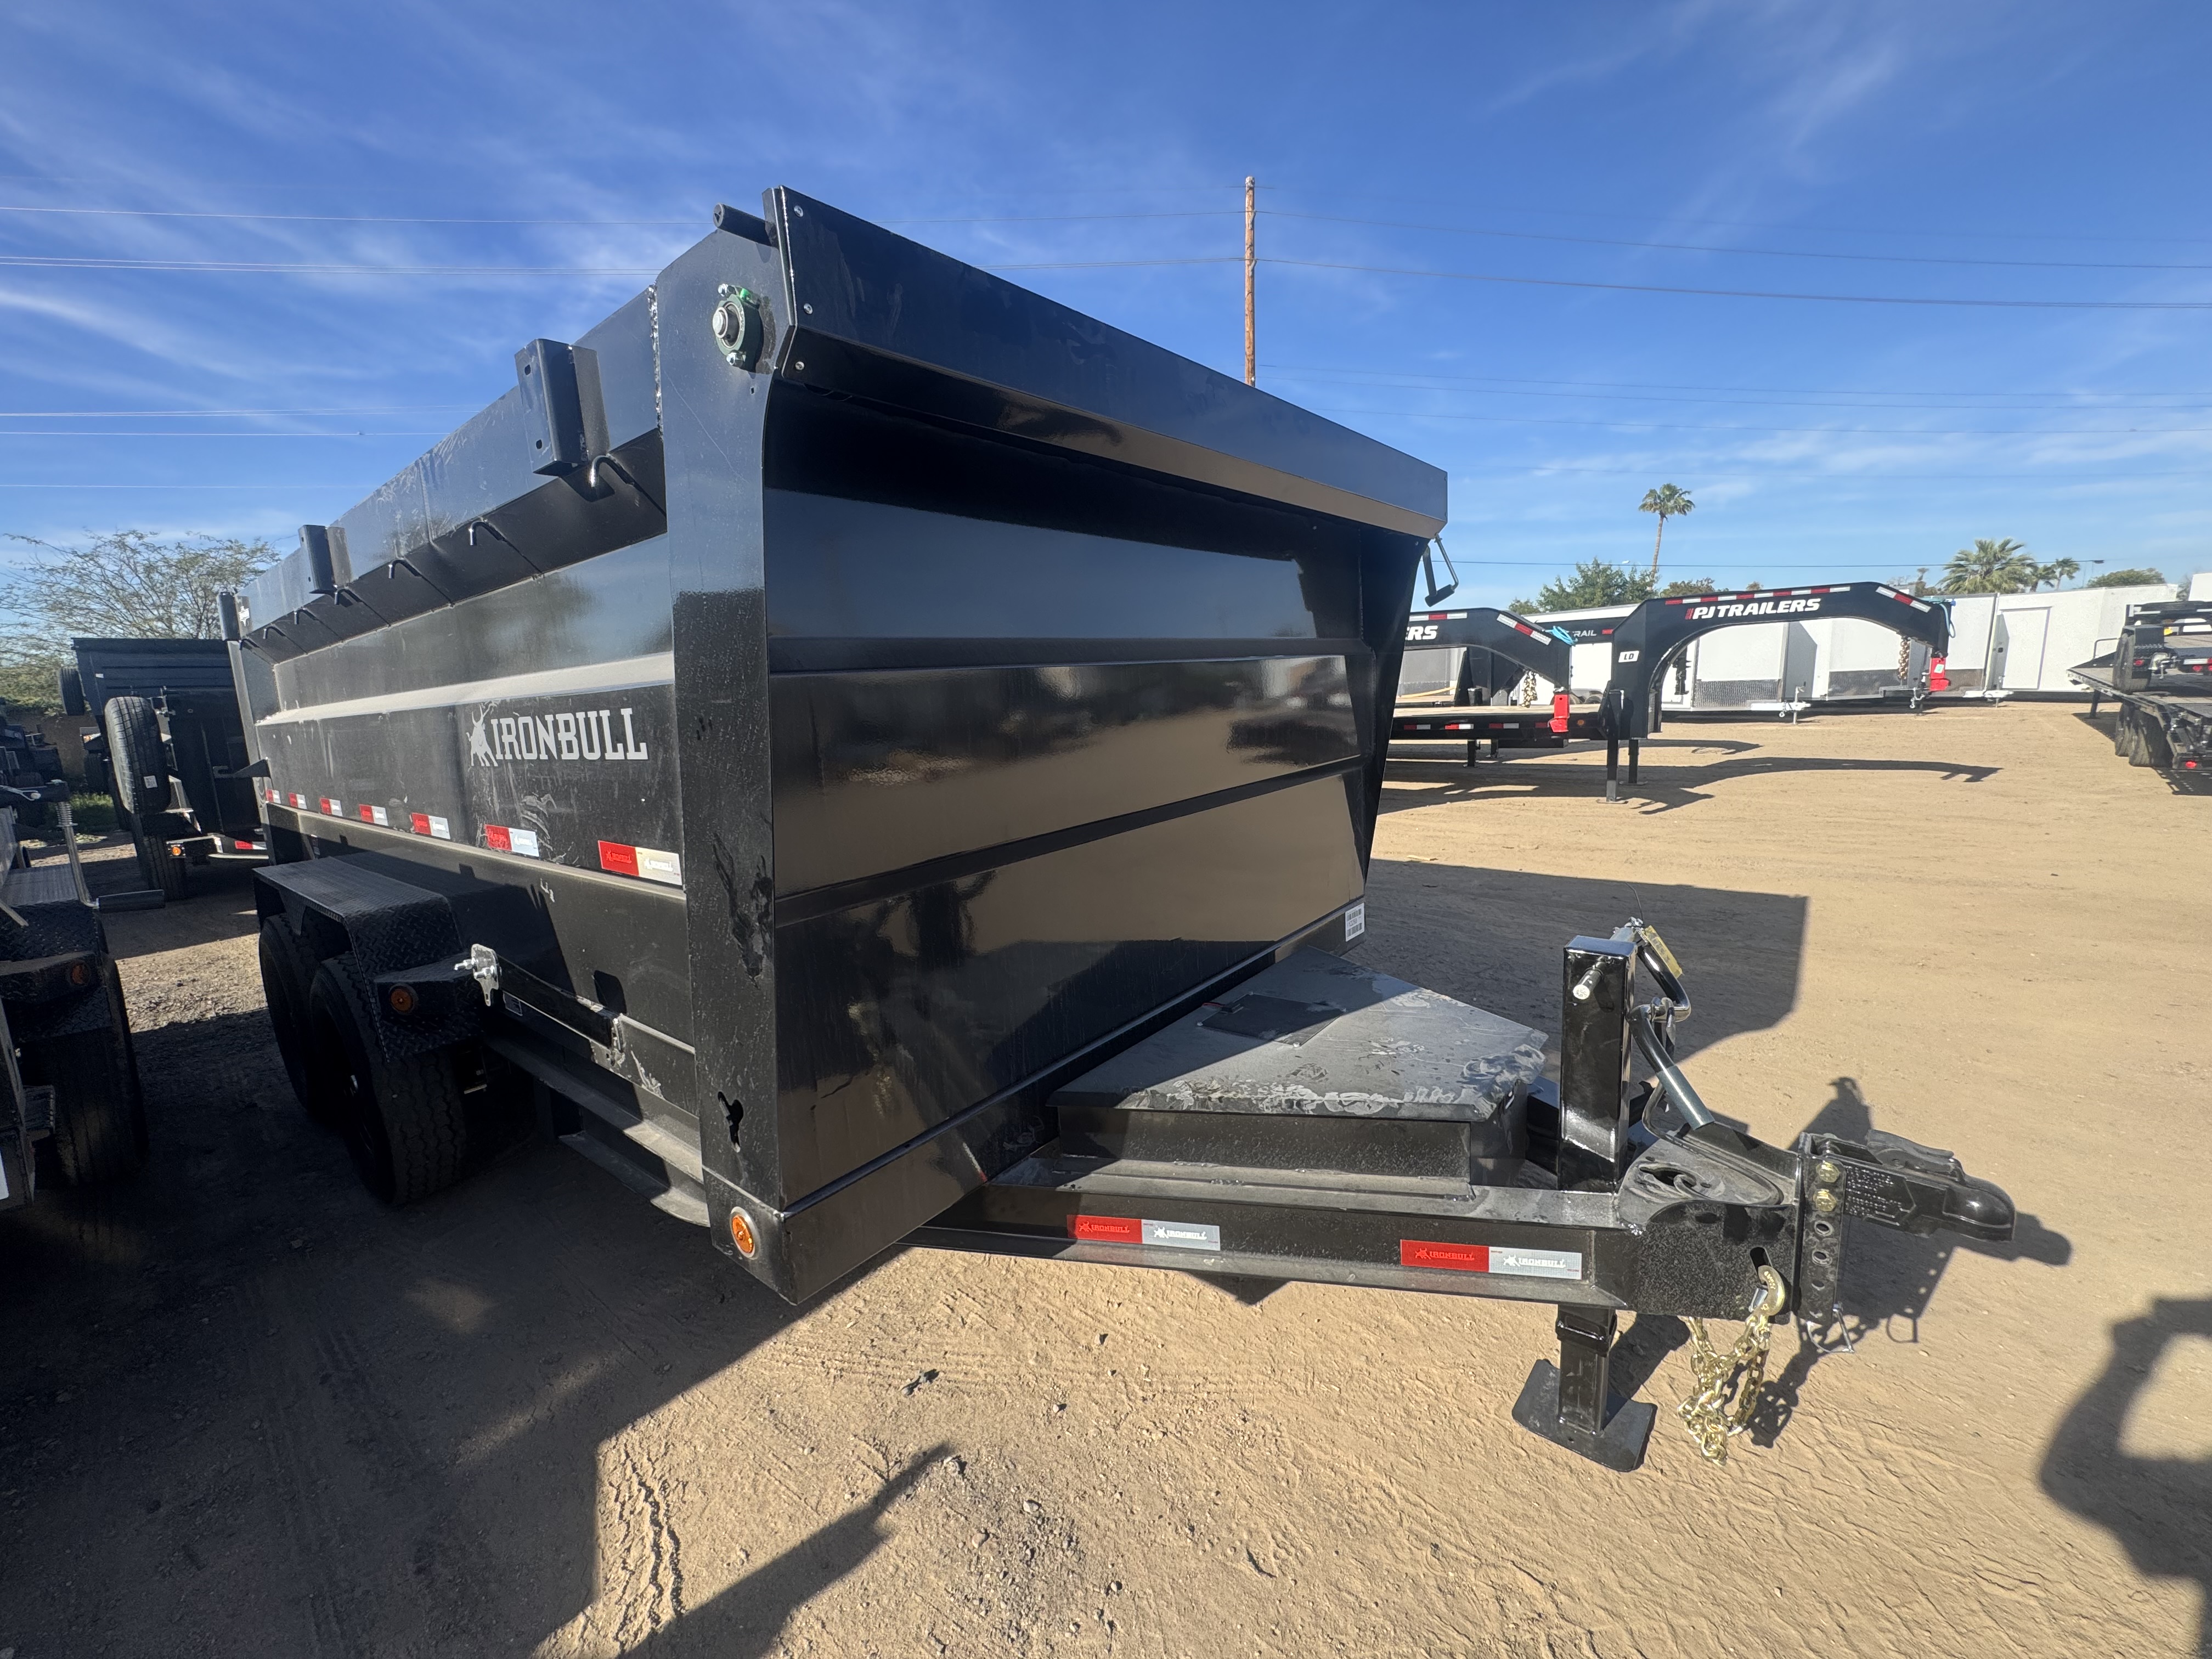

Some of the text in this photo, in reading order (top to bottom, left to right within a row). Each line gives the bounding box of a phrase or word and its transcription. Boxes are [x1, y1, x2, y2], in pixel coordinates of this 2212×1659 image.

[1692, 598, 1821, 620] PJ TRAILERS
[1405, 625, 1438, 641] RS
[490, 708, 648, 760] IRONBULL
[1091, 1223, 1131, 1234] IRONBULL
[1167, 1229, 1207, 1240] IRONBULL
[1429, 1250, 1475, 1261] IRONBULL
[1517, 1257, 1566, 1269] IRONBULL
